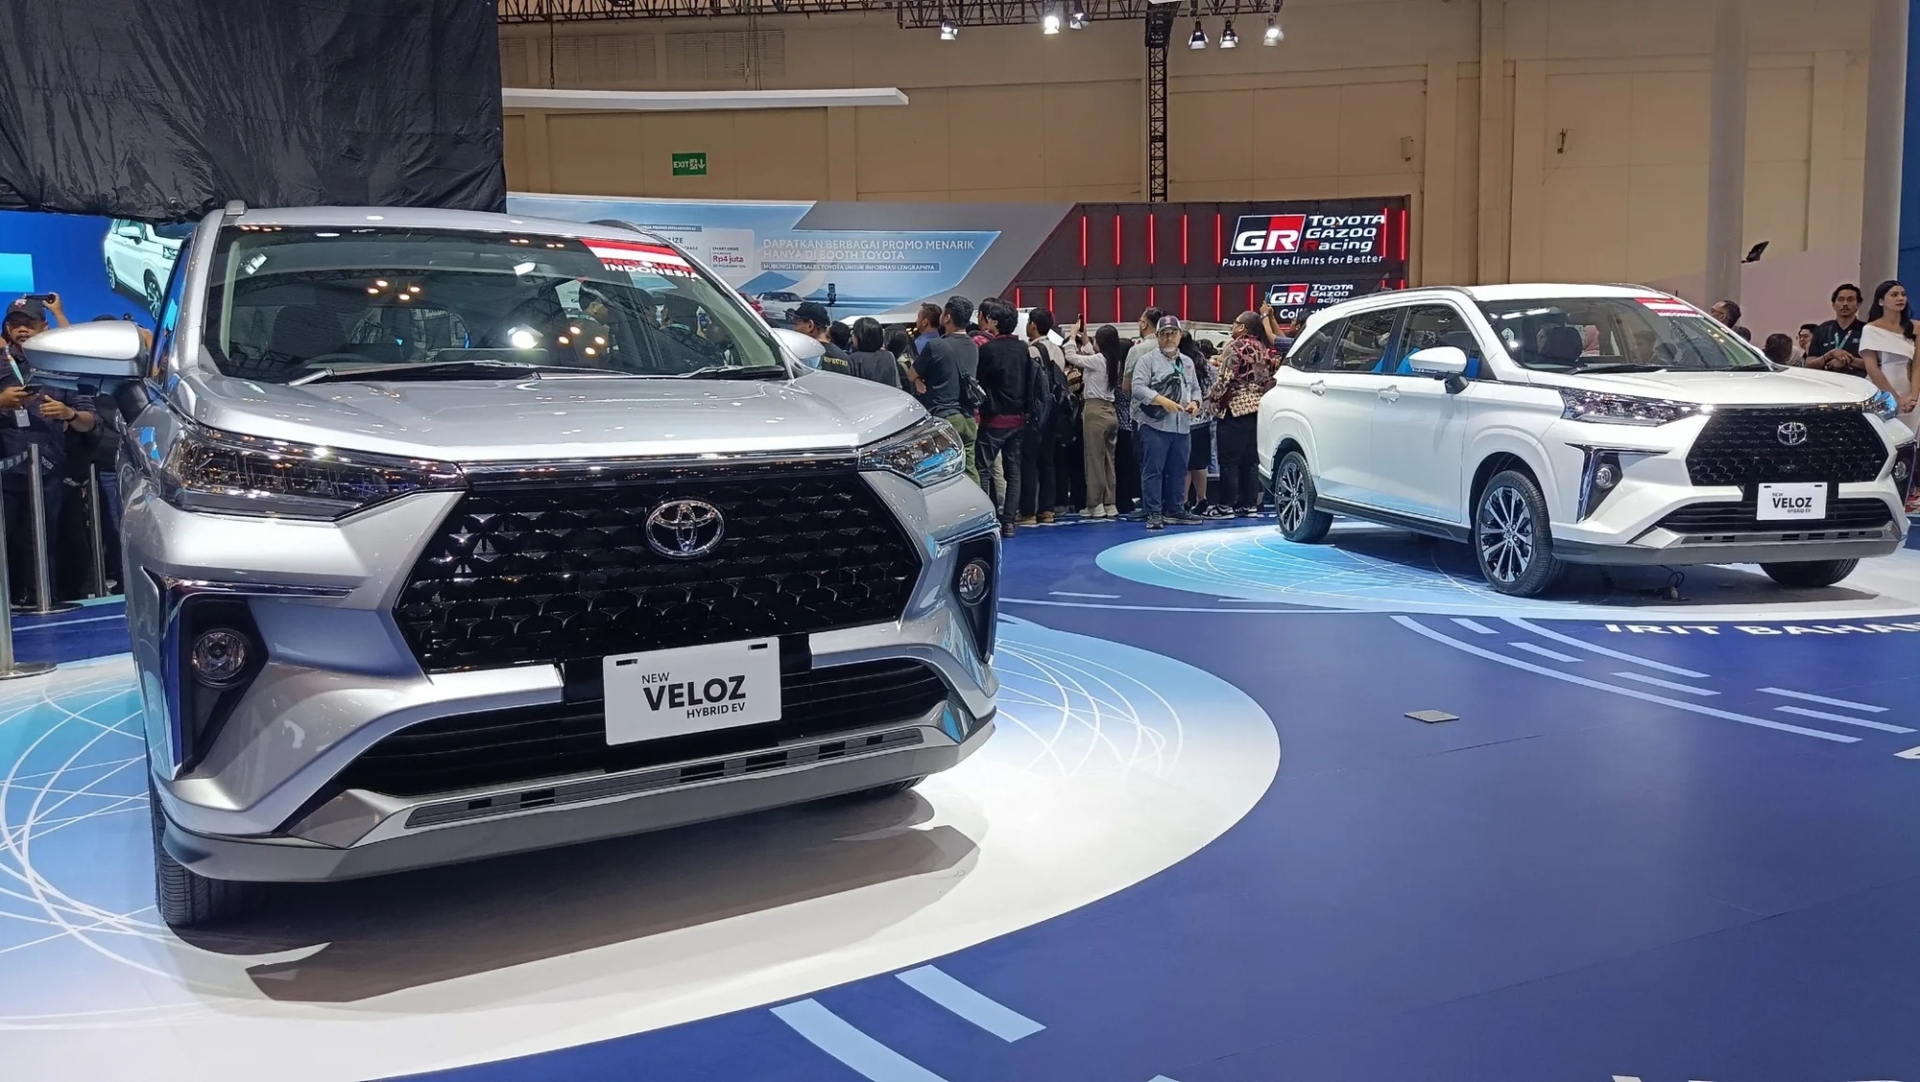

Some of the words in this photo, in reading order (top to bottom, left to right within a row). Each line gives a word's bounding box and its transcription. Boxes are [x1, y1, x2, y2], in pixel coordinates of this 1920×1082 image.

[1309, 214, 1386, 227] TOYOTA
[1235, 230, 1299, 251] GR
[1305, 228, 1377, 240] GAZOO
[763, 239, 822, 249] DAPATKAN
[826, 240, 880, 249] BERBAGAI
[883, 240, 923, 250] PROMO
[926, 240, 975, 250] MENARIK
[1303, 239, 1373, 253] Racing
[764, 250, 801, 260] HANYA
[806, 250, 816, 260] DI
[820, 250, 859, 260] BOOTH
[861, 250, 905, 260] TOYOTA
[1222, 258, 1268, 267] Pushing
[1271, 256, 1290, 266] the
[1292, 256, 1325, 265] limits
[1328, 255, 1345, 264] for
[1346, 254, 1384, 264] Better
[603, 264, 702, 281] INDONESIA
[1270, 291, 1304, 304] GR
[1772, 497, 1812, 509] VELOZ
[1605, 624, 1720, 635] IRIT
[641, 672, 670, 684] NEW
[643, 675, 746, 711] VELOZ
[686, 705, 729, 719] HYBRID
[731, 702, 746, 713] EV
